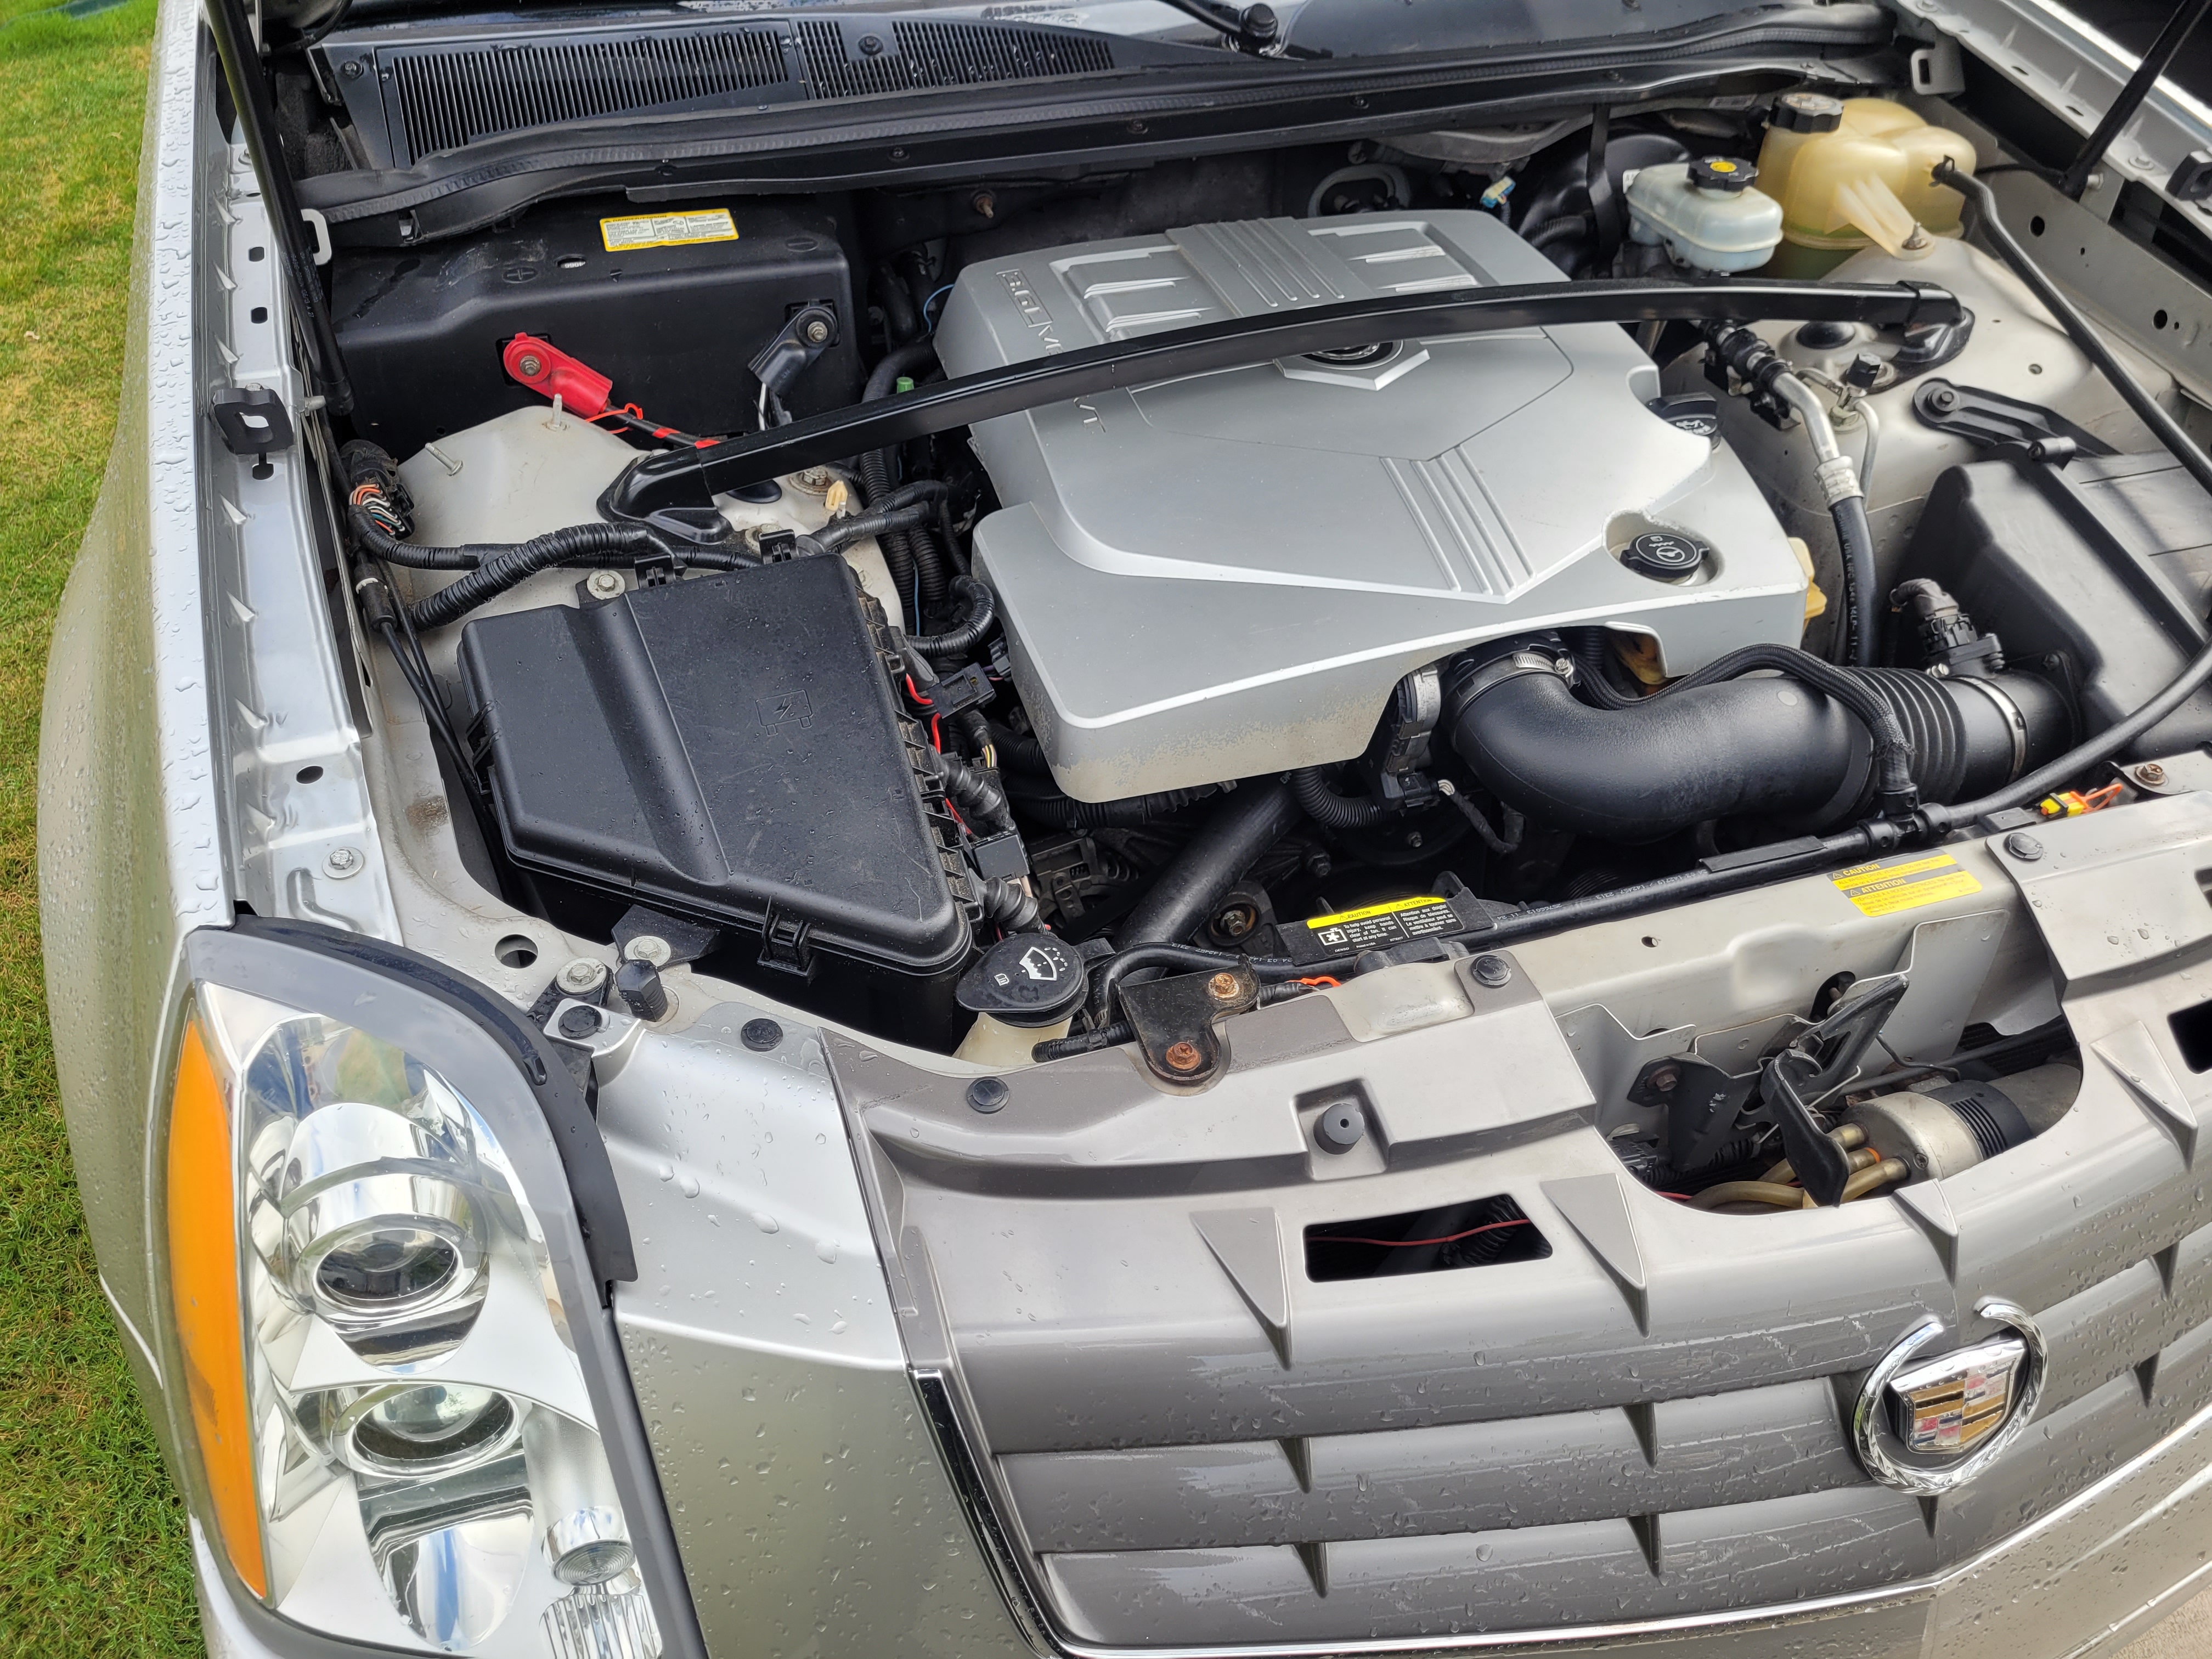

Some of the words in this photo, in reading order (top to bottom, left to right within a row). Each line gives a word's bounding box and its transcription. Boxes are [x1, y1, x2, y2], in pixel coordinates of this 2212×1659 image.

[1002, 272, 1041, 325] 3.6L
[1843, 864, 1881, 876] CAUTION
[1861, 878, 1906, 893] ATTENTION
[1404, 899, 1432, 907] ATTENTION
